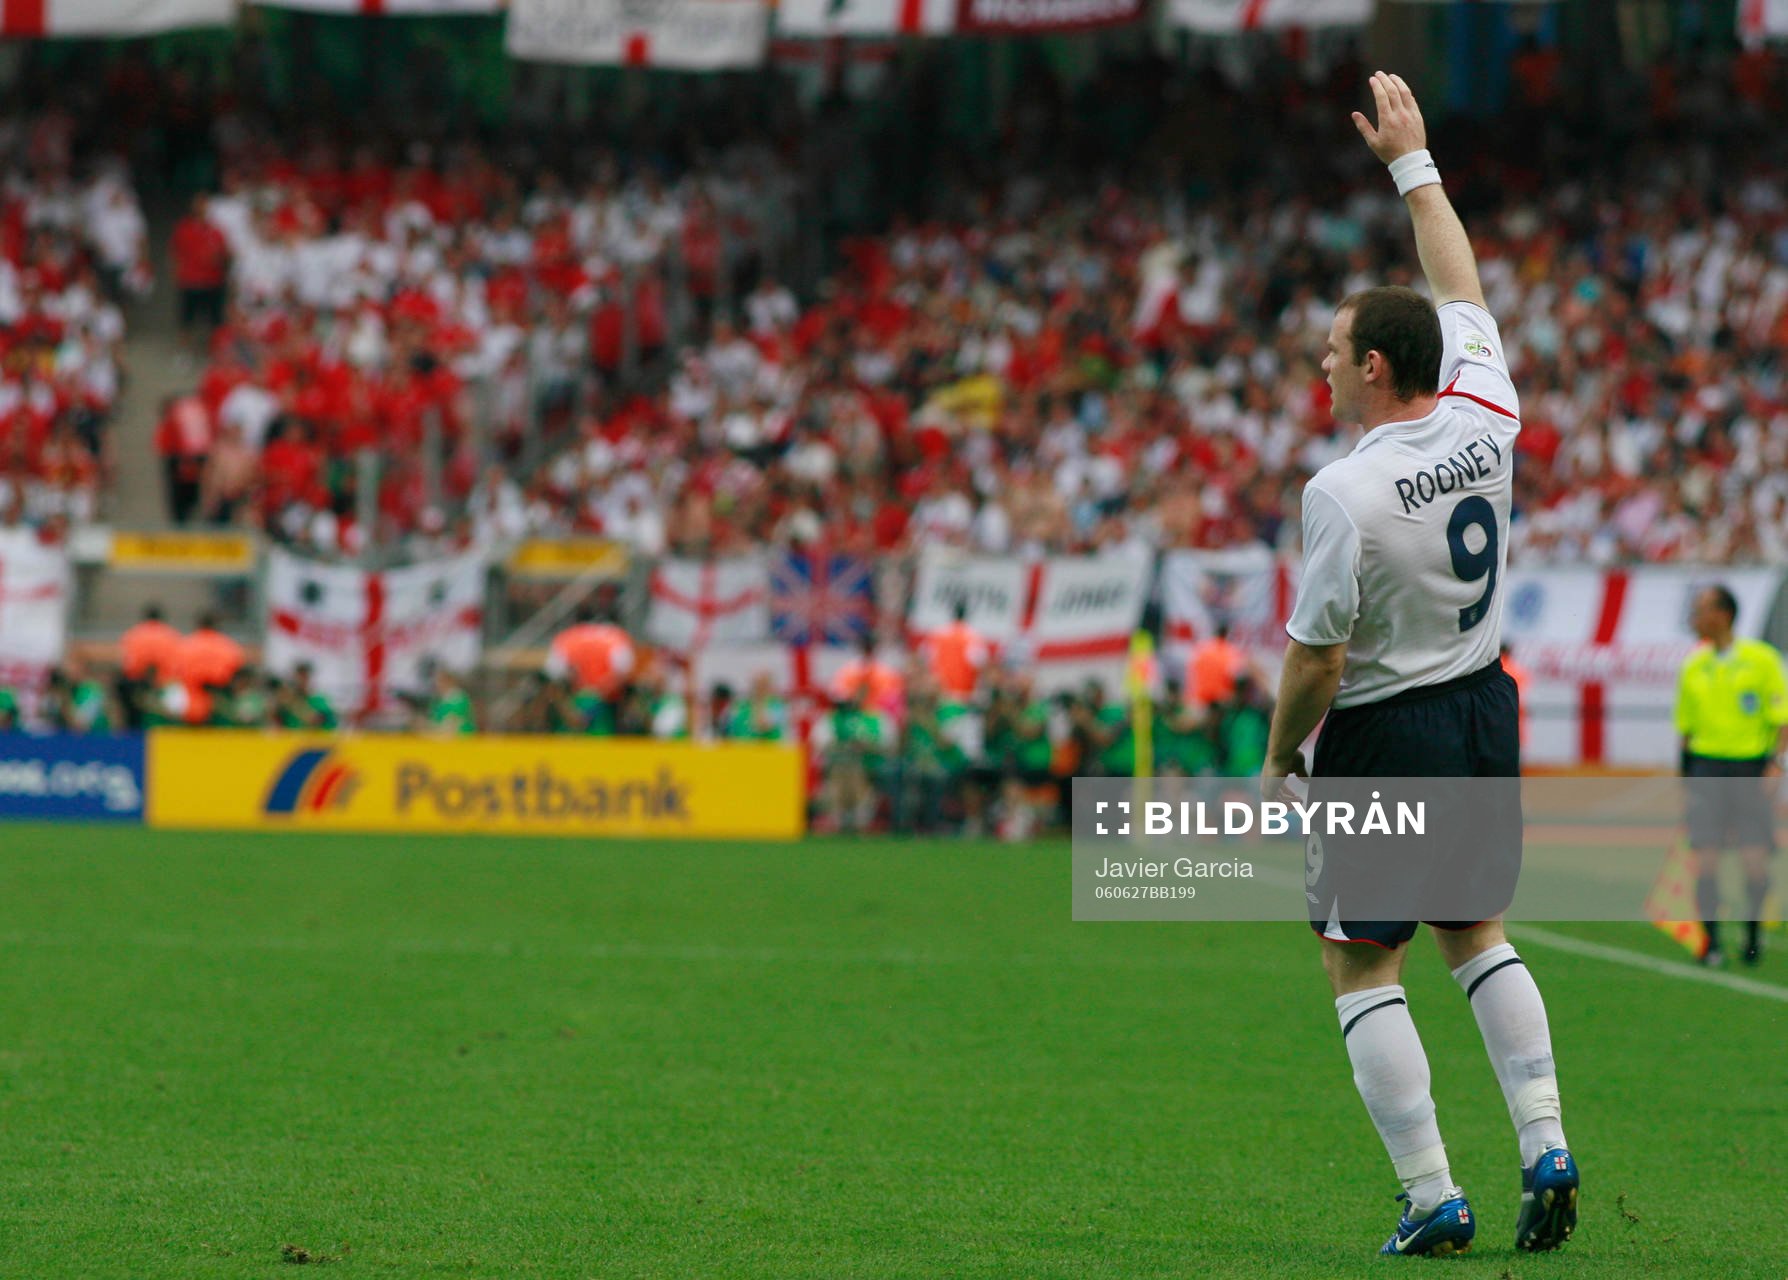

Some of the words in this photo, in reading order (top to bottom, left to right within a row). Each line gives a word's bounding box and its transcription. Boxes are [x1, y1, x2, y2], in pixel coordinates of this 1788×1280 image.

[1395, 434, 1501, 514] ROONEY
[1447, 495, 1498, 633] 9
[395, 762, 690, 822] Postbank
[1306, 831, 1324, 887] 9
